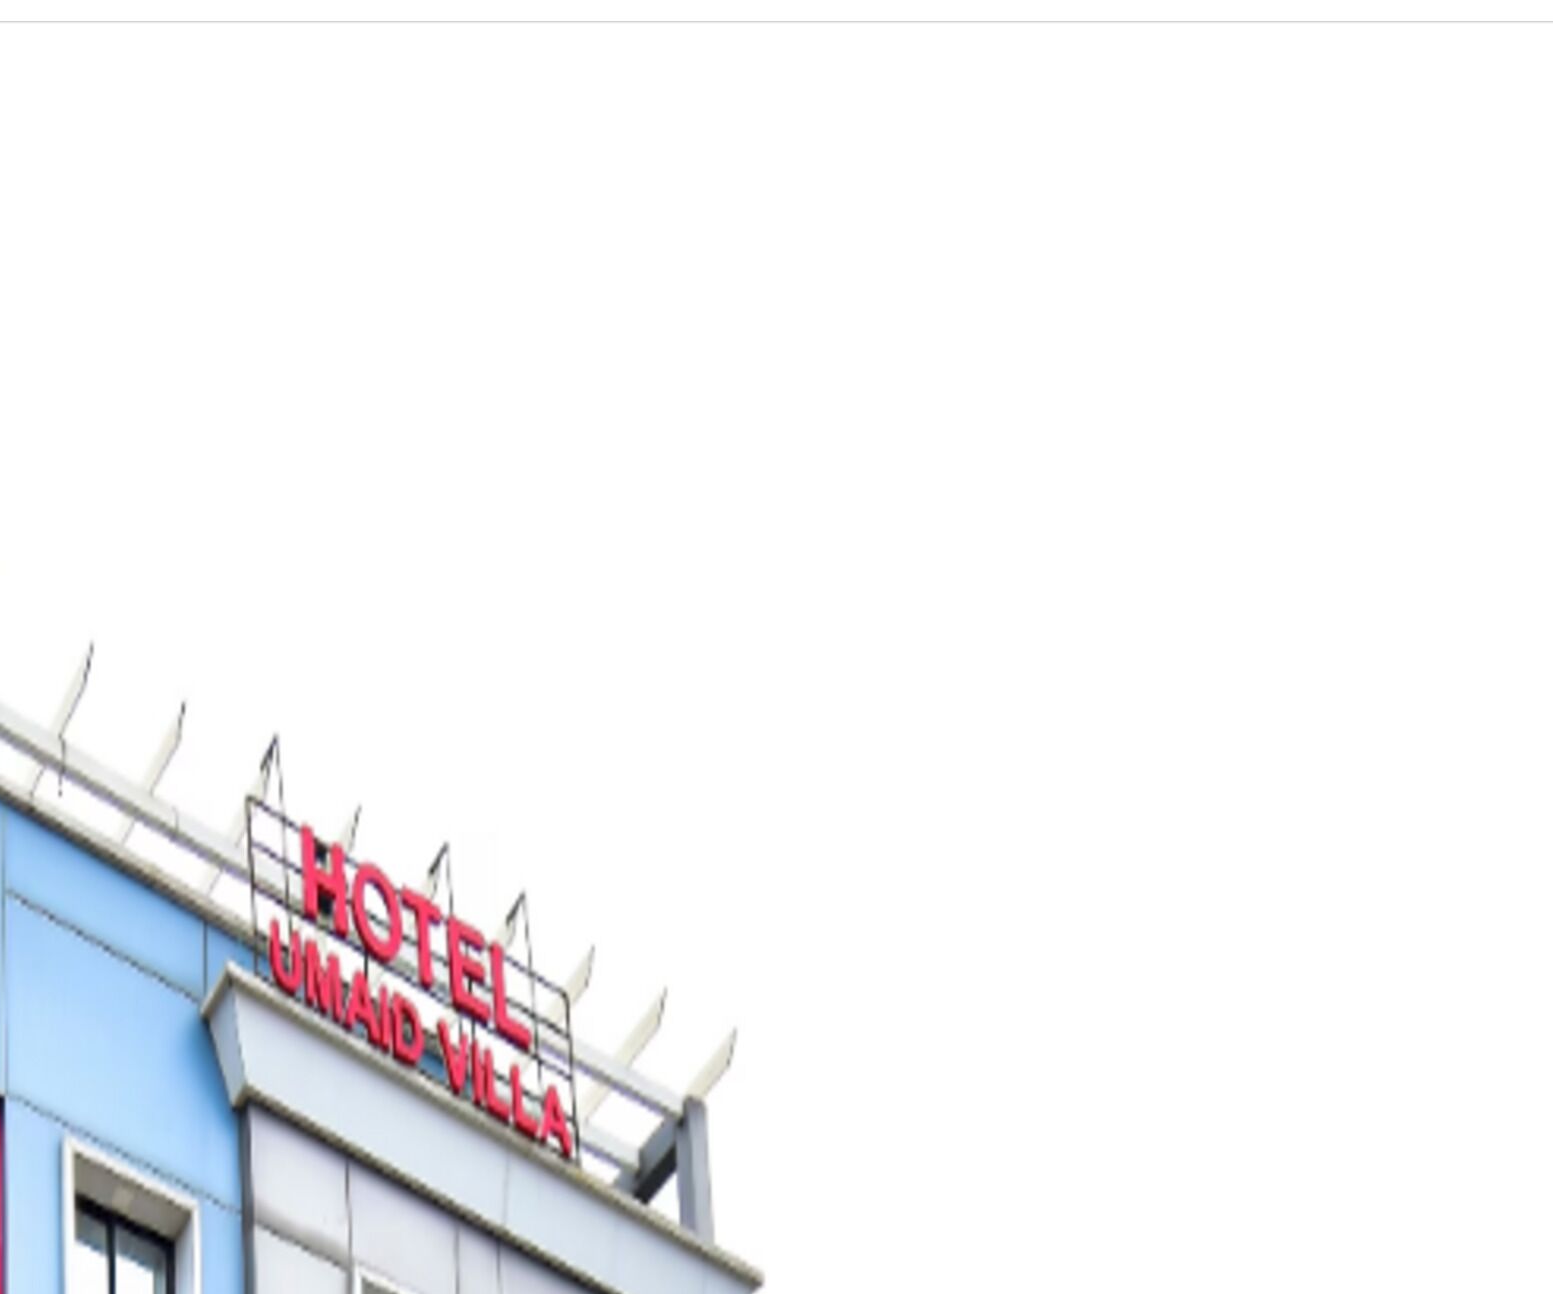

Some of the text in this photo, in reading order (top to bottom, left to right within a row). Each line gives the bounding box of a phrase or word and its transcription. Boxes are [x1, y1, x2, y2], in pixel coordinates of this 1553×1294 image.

[268, 918, 573, 1158] UMAID VILLA
[299, 823, 532, 1050] HOTEL
